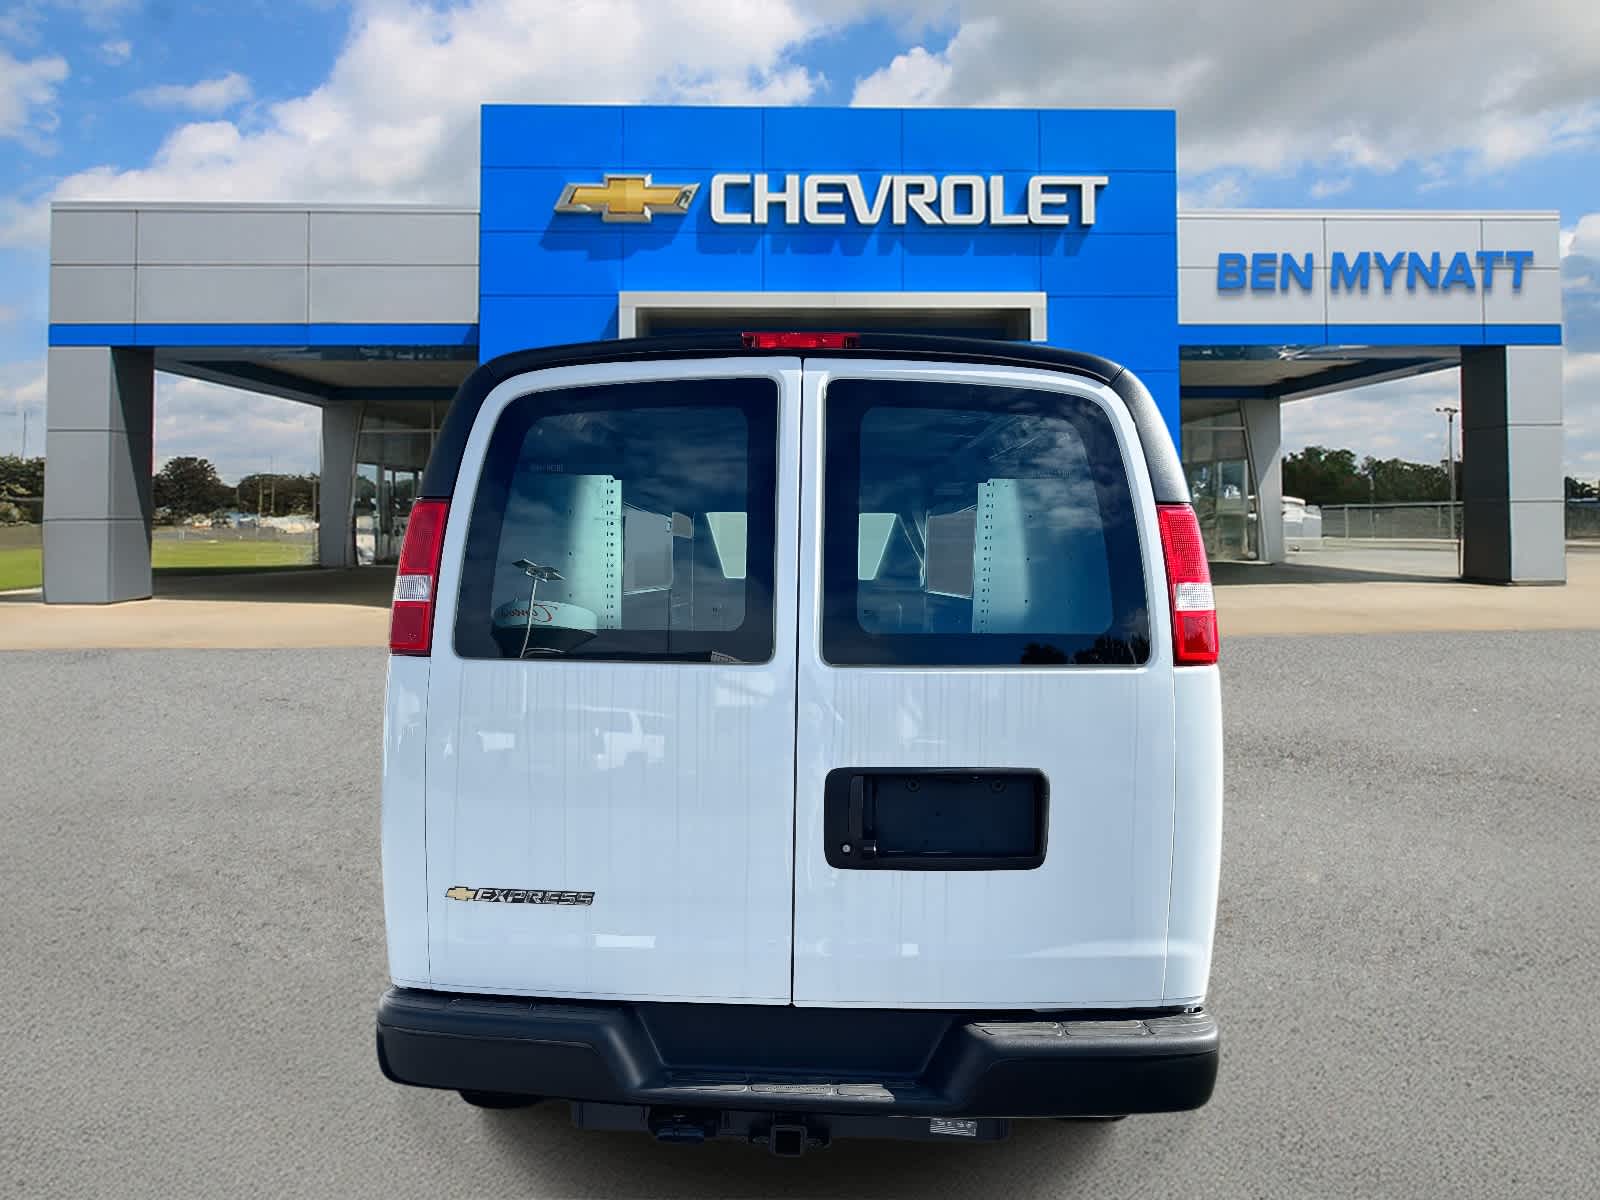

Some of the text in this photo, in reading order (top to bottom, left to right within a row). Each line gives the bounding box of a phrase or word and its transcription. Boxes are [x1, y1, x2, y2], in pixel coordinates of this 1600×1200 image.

[709, 173, 1109, 226] CHEVROLET
[1217, 250, 1534, 291] BEN MYNATT
[474, 888, 595, 906] EXPRESS
